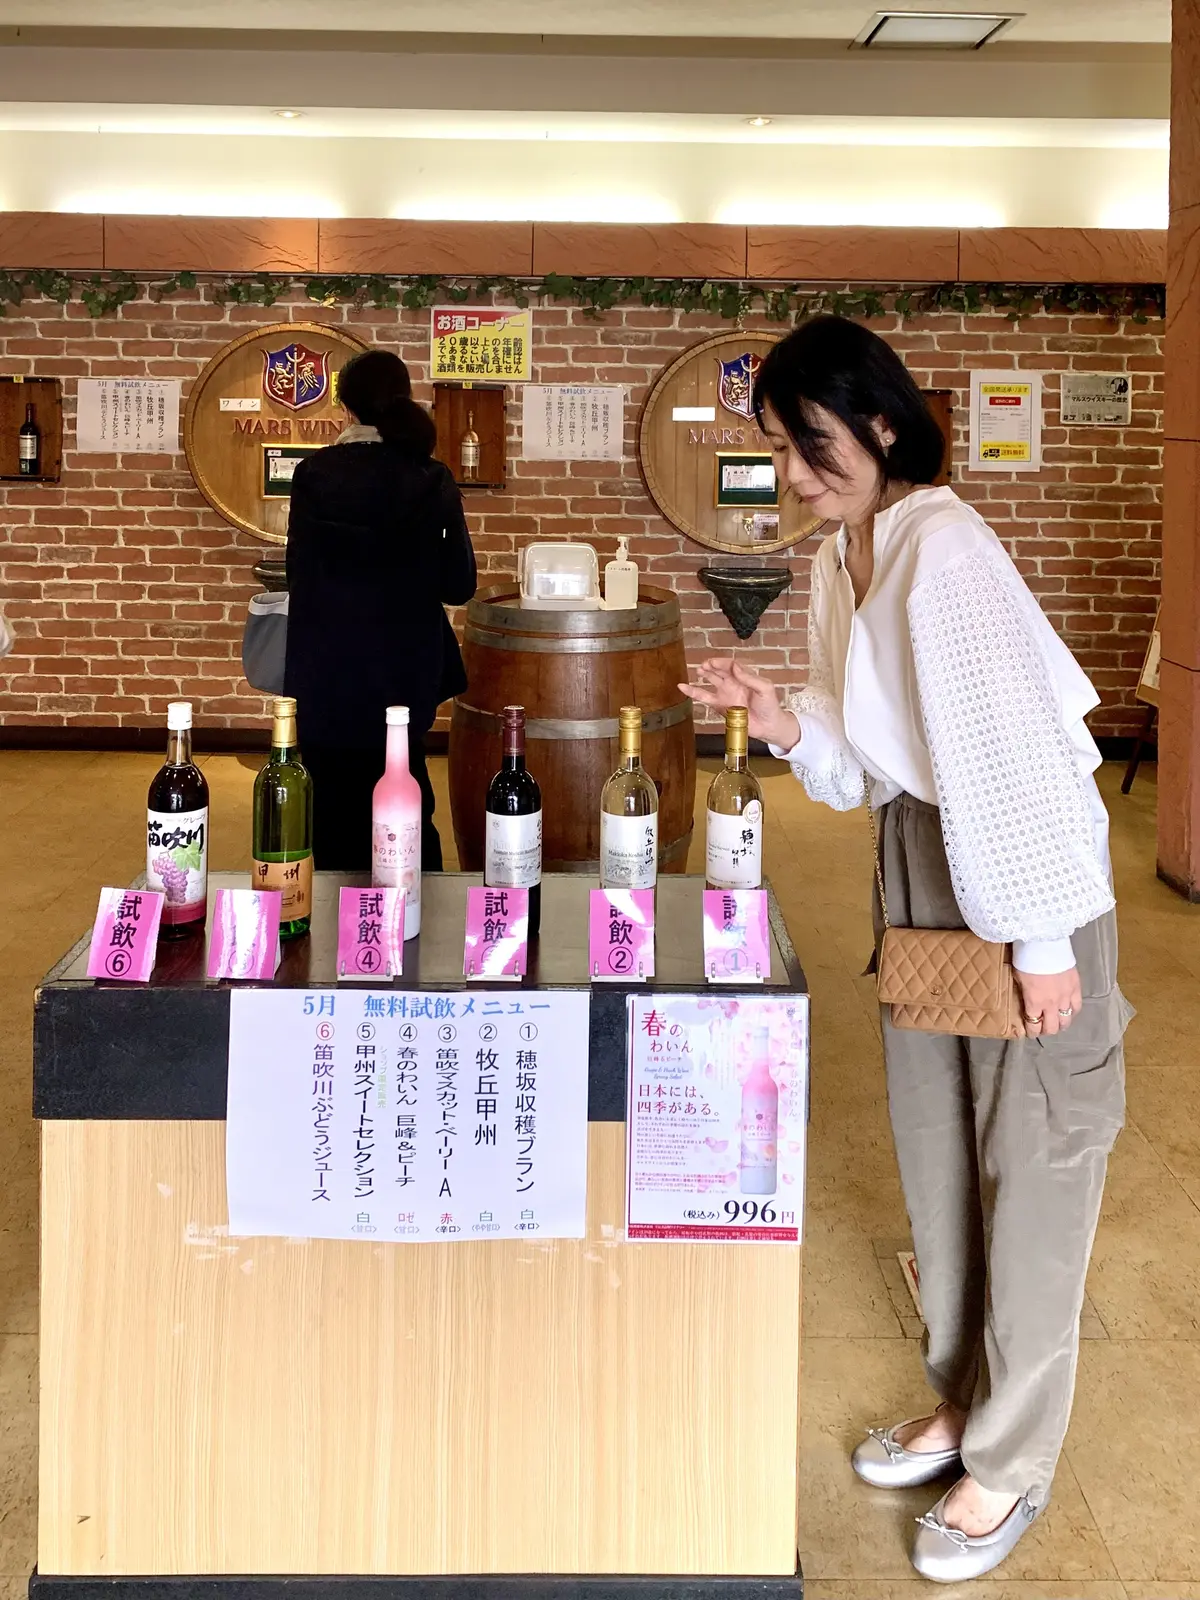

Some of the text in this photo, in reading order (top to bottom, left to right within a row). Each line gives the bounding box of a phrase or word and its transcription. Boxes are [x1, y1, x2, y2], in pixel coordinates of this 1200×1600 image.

[437, 315, 524, 332] お酒コーナー
[438, 346, 523, 355] であることを確認
[438, 354, 522, 365] できない場合には
[437, 363, 522, 374] 酒類を販売しません
[222, 400, 257, 408] ワイン
[233, 418, 344, 436] MARS WIN
[688, 427, 745, 444] MARS
[148, 821, 204, 853] 笛吹川
[258, 862, 300, 882] 甲州
[110, 895, 142, 949] 試飲
[357, 893, 383, 945] 試飲
[303, 995, 550, 1019] 5月 無料試飲メニュー
[641, 1009, 683, 1037] 春の
[650, 1039, 693, 1053] わいん
[474, 1048, 499, 1146] 牧丘甲州
[640, 1084, 704, 1099] 日本には、
[637, 1101, 719, 1116] 四季がある。
[311, 1044, 335, 1201] 笛吹川ぶどうジュース
[353, 1045, 376, 1198] 甲州スイートセレクション
[515, 1050, 537, 1192] 穂坂収穫ブラン
[440, 1213, 453, 1224] 赤
